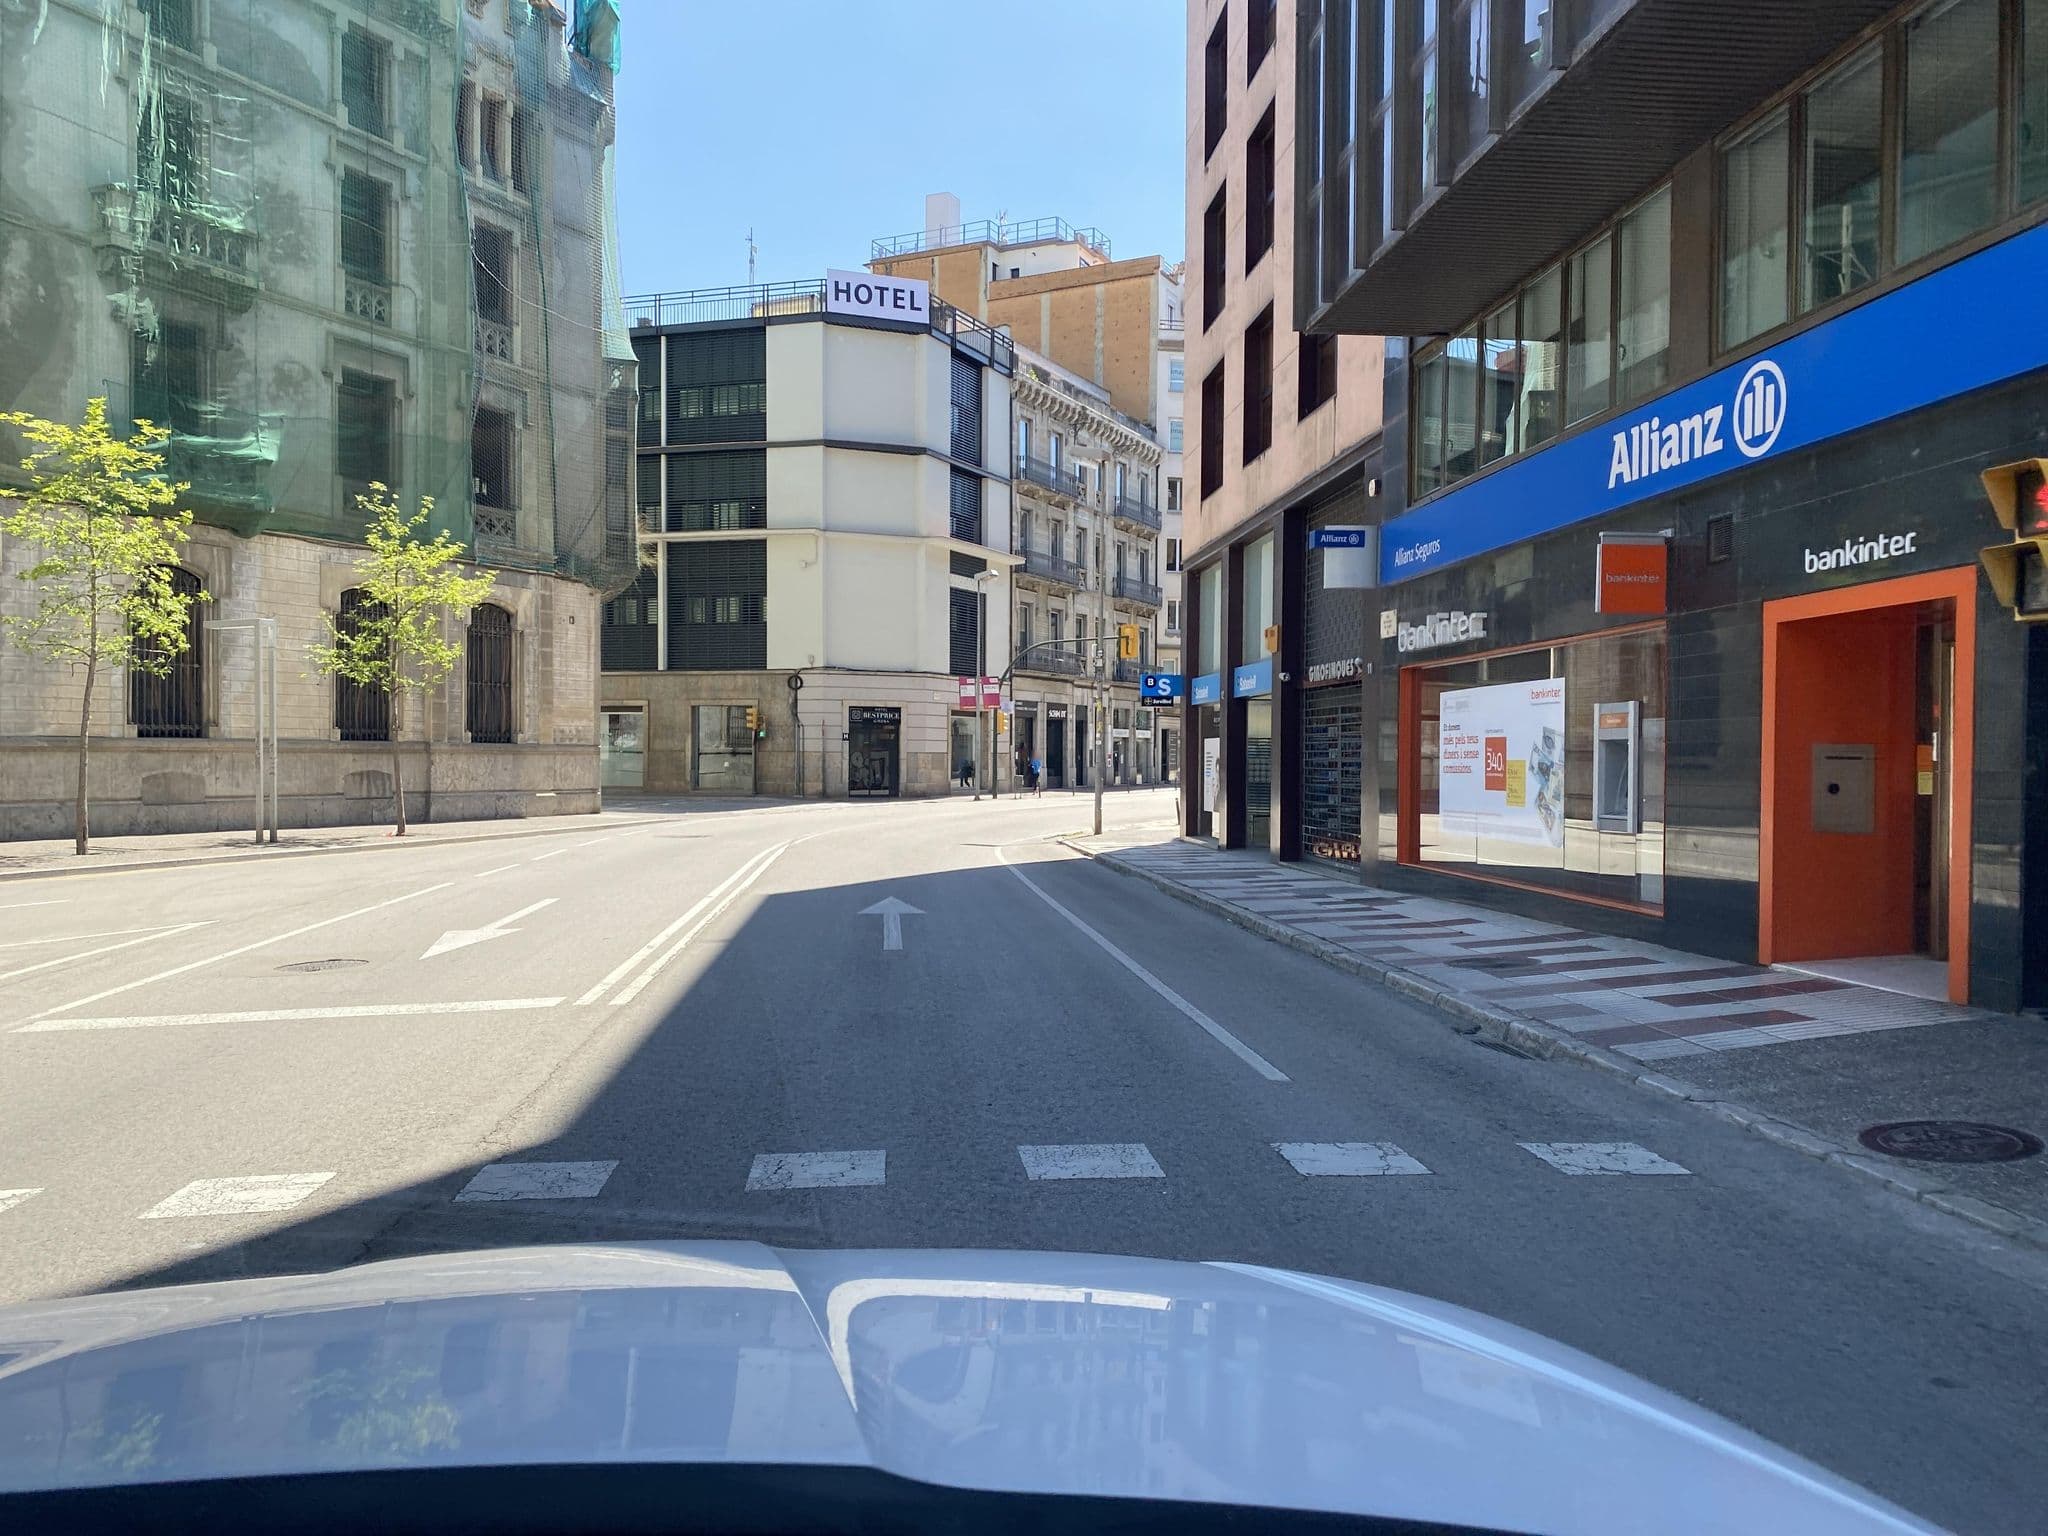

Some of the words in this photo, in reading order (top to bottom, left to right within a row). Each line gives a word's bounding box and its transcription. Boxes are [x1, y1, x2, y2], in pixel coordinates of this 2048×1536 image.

[834, 280, 922, 311] HOTEL
[1608, 404, 1723, 489] Allianz
[1320, 534, 1347, 543] Allianz
[1394, 546, 1414, 567] Allianz
[1415, 539, 1440, 562] Seguros
[1157, 678, 1172, 696] S
